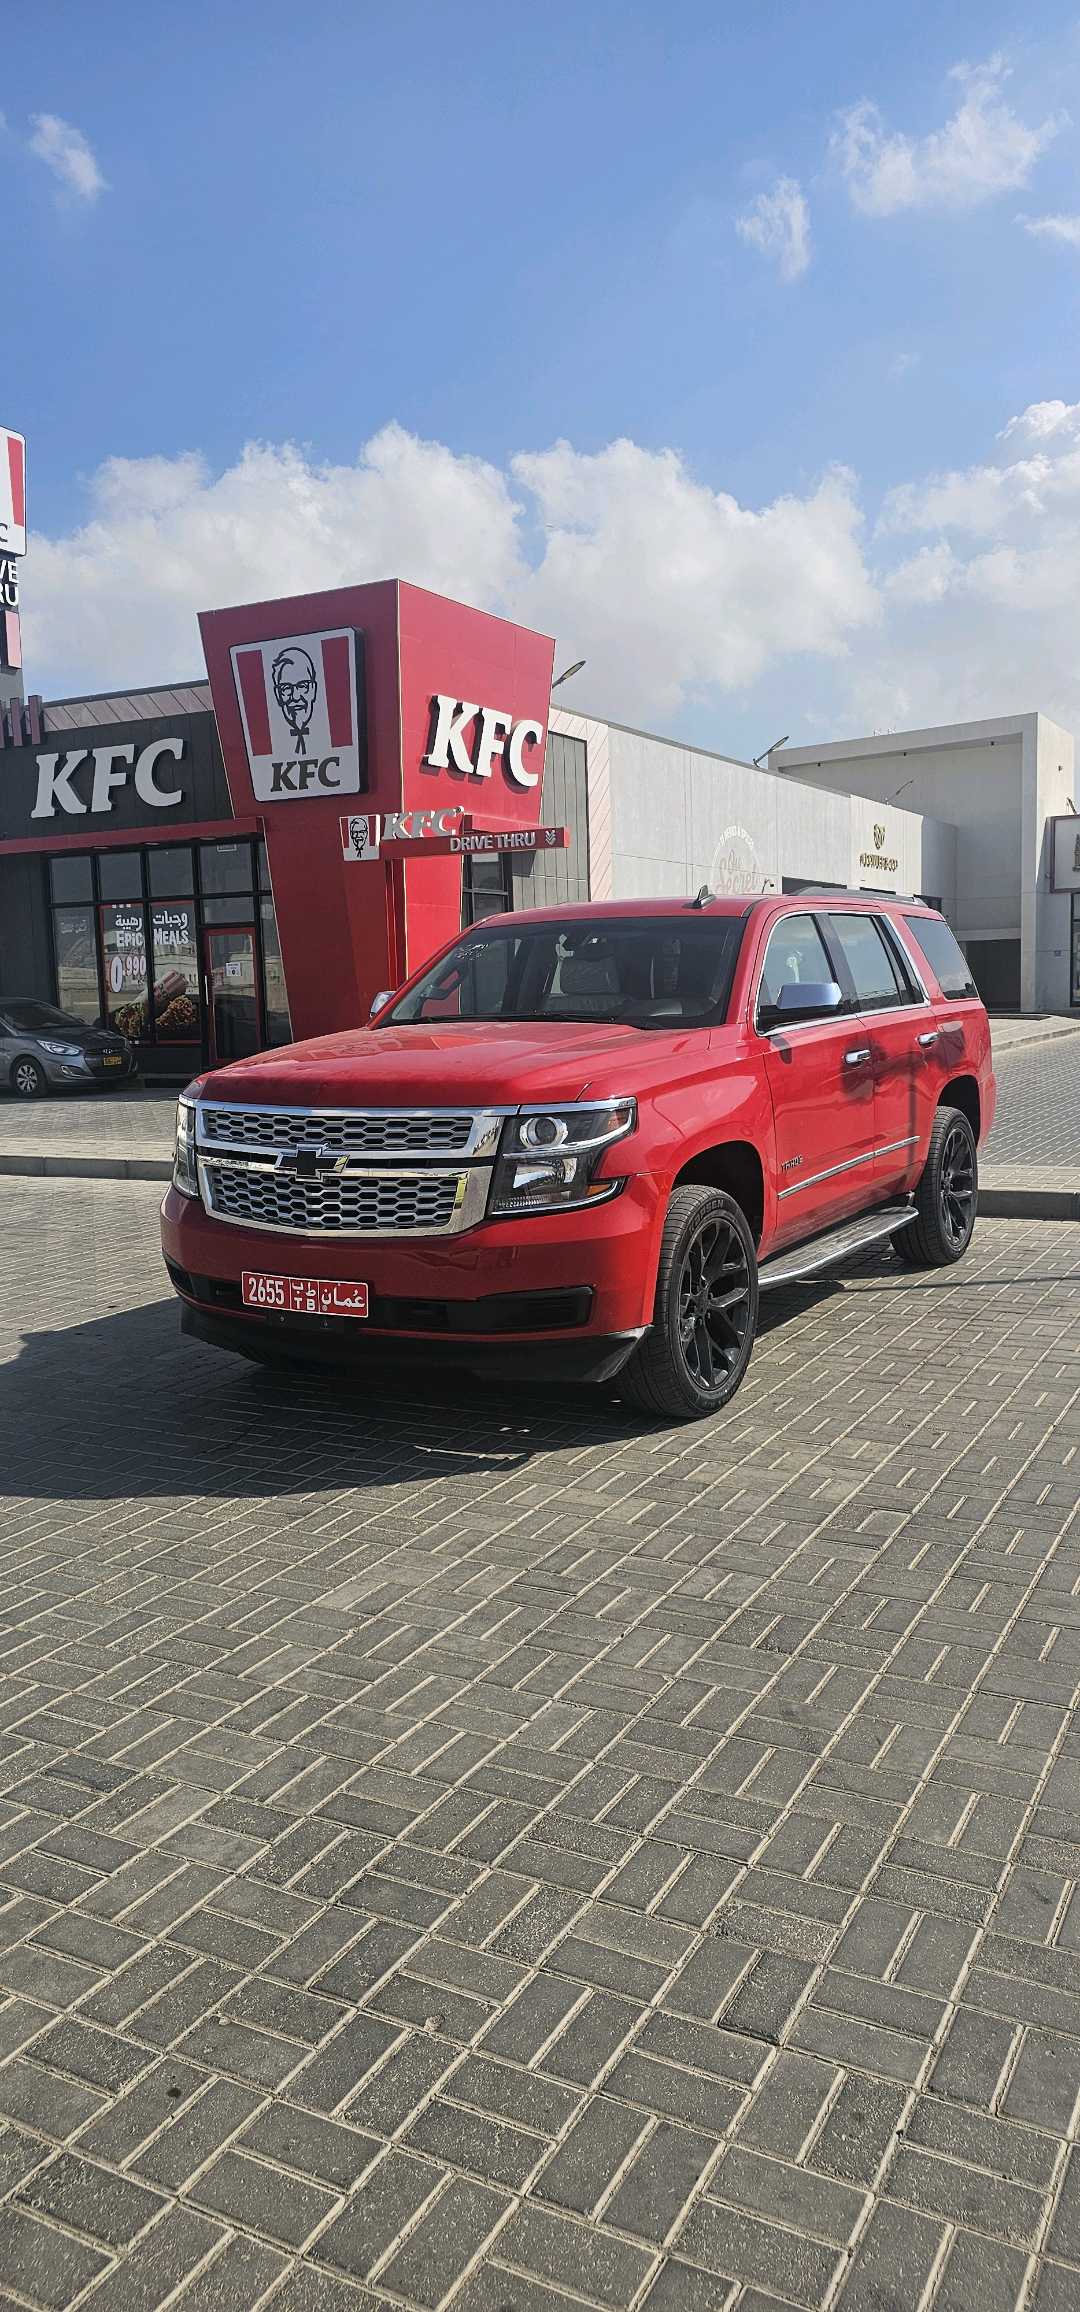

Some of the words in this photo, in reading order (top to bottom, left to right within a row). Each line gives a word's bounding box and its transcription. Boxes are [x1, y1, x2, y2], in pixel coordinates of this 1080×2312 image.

[424, 695, 543, 787] KFC
[31, 738, 184, 819] KFC
[270, 756, 341, 792] KFC
[450, 835, 493, 852] DRIVE
[497, 832, 536, 848] THRU
[115, 914, 143, 932] رهيبة
[152, 911, 188, 930] وجبات
[153, 928, 189, 946] MEALS
[248, 1277, 285, 1305] 2655
